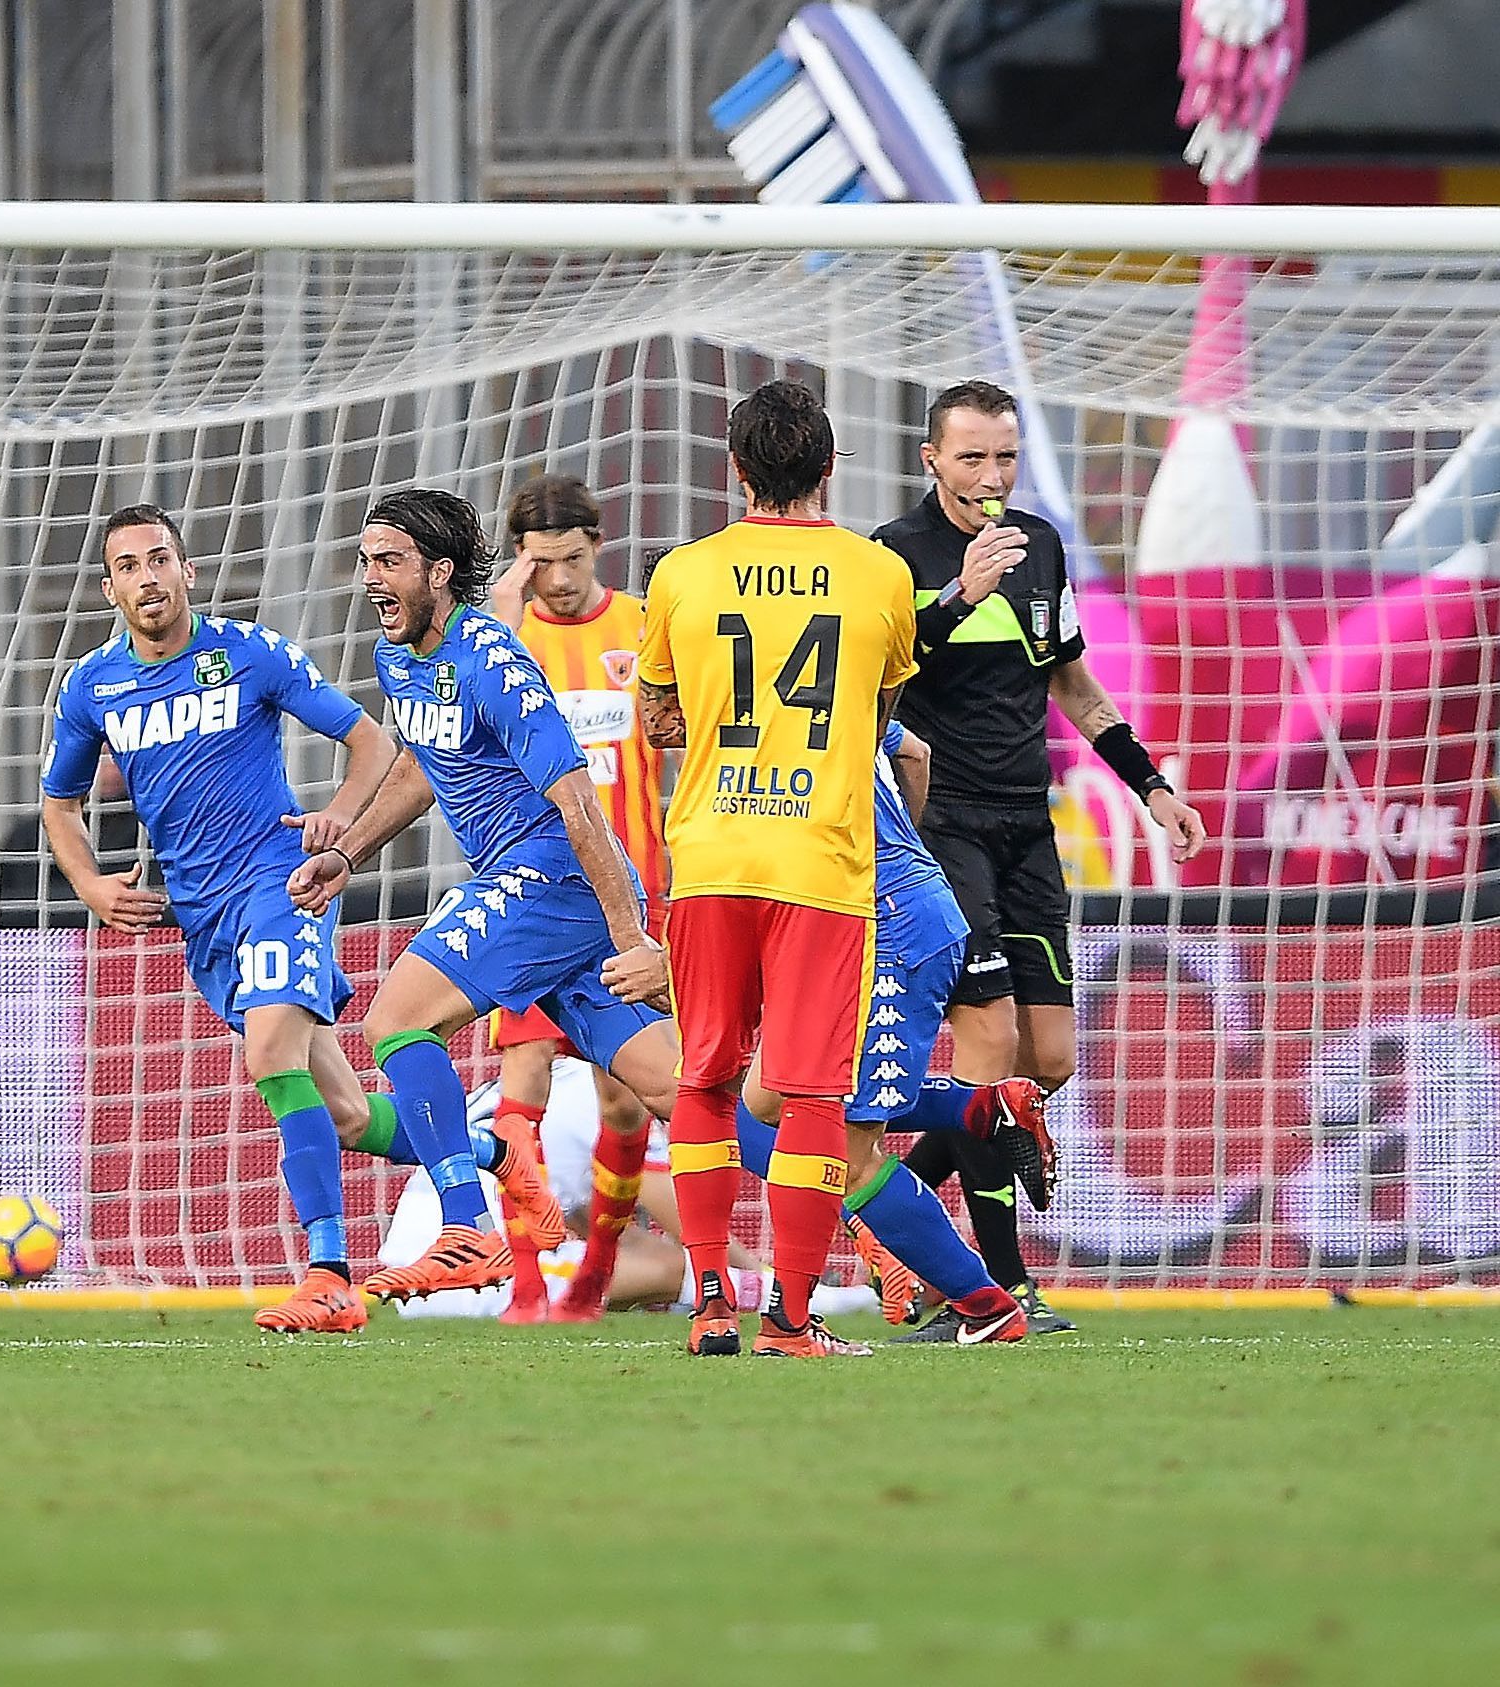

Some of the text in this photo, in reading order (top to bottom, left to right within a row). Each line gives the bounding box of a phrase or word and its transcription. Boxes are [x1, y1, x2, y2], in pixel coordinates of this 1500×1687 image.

[732, 565, 830, 597] VIOLA
[716, 613, 842, 750] 14
[104, 683, 241, 754] MAPEI
[391, 696, 463, 750] MAPEI
[717, 765, 813, 797] RILLO
[712, 794, 811, 819] COSTRUZIONI
